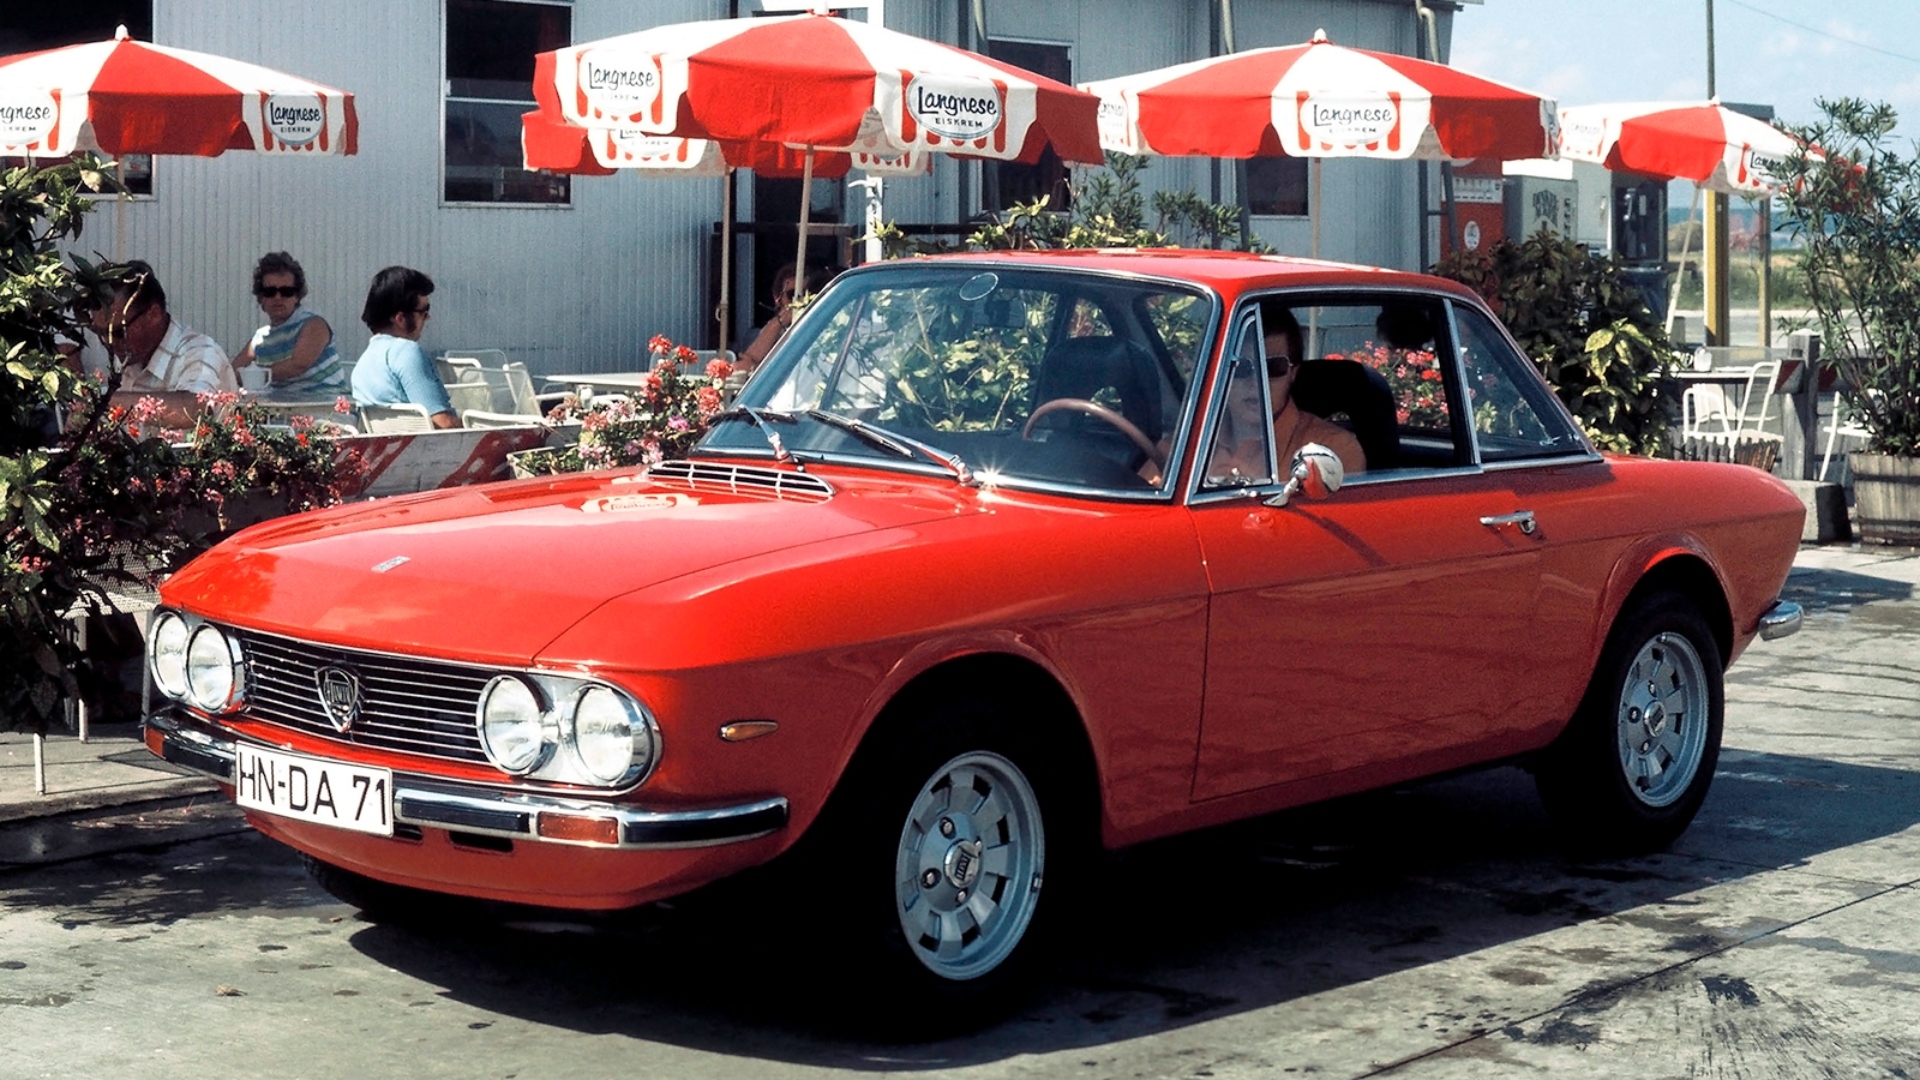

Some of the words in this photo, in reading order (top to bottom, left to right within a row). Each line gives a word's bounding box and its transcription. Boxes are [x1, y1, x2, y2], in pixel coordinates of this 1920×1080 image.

[588, 62, 655, 91] Langnese
[270, 102, 321, 125] Langnese
[918, 85, 997, 116] Langnese
[935, 117, 983, 127] EISKREM
[1313, 104, 1392, 126] Langnese
[239, 751, 339, 819] HN-DA
[352, 774, 386, 826] 71
